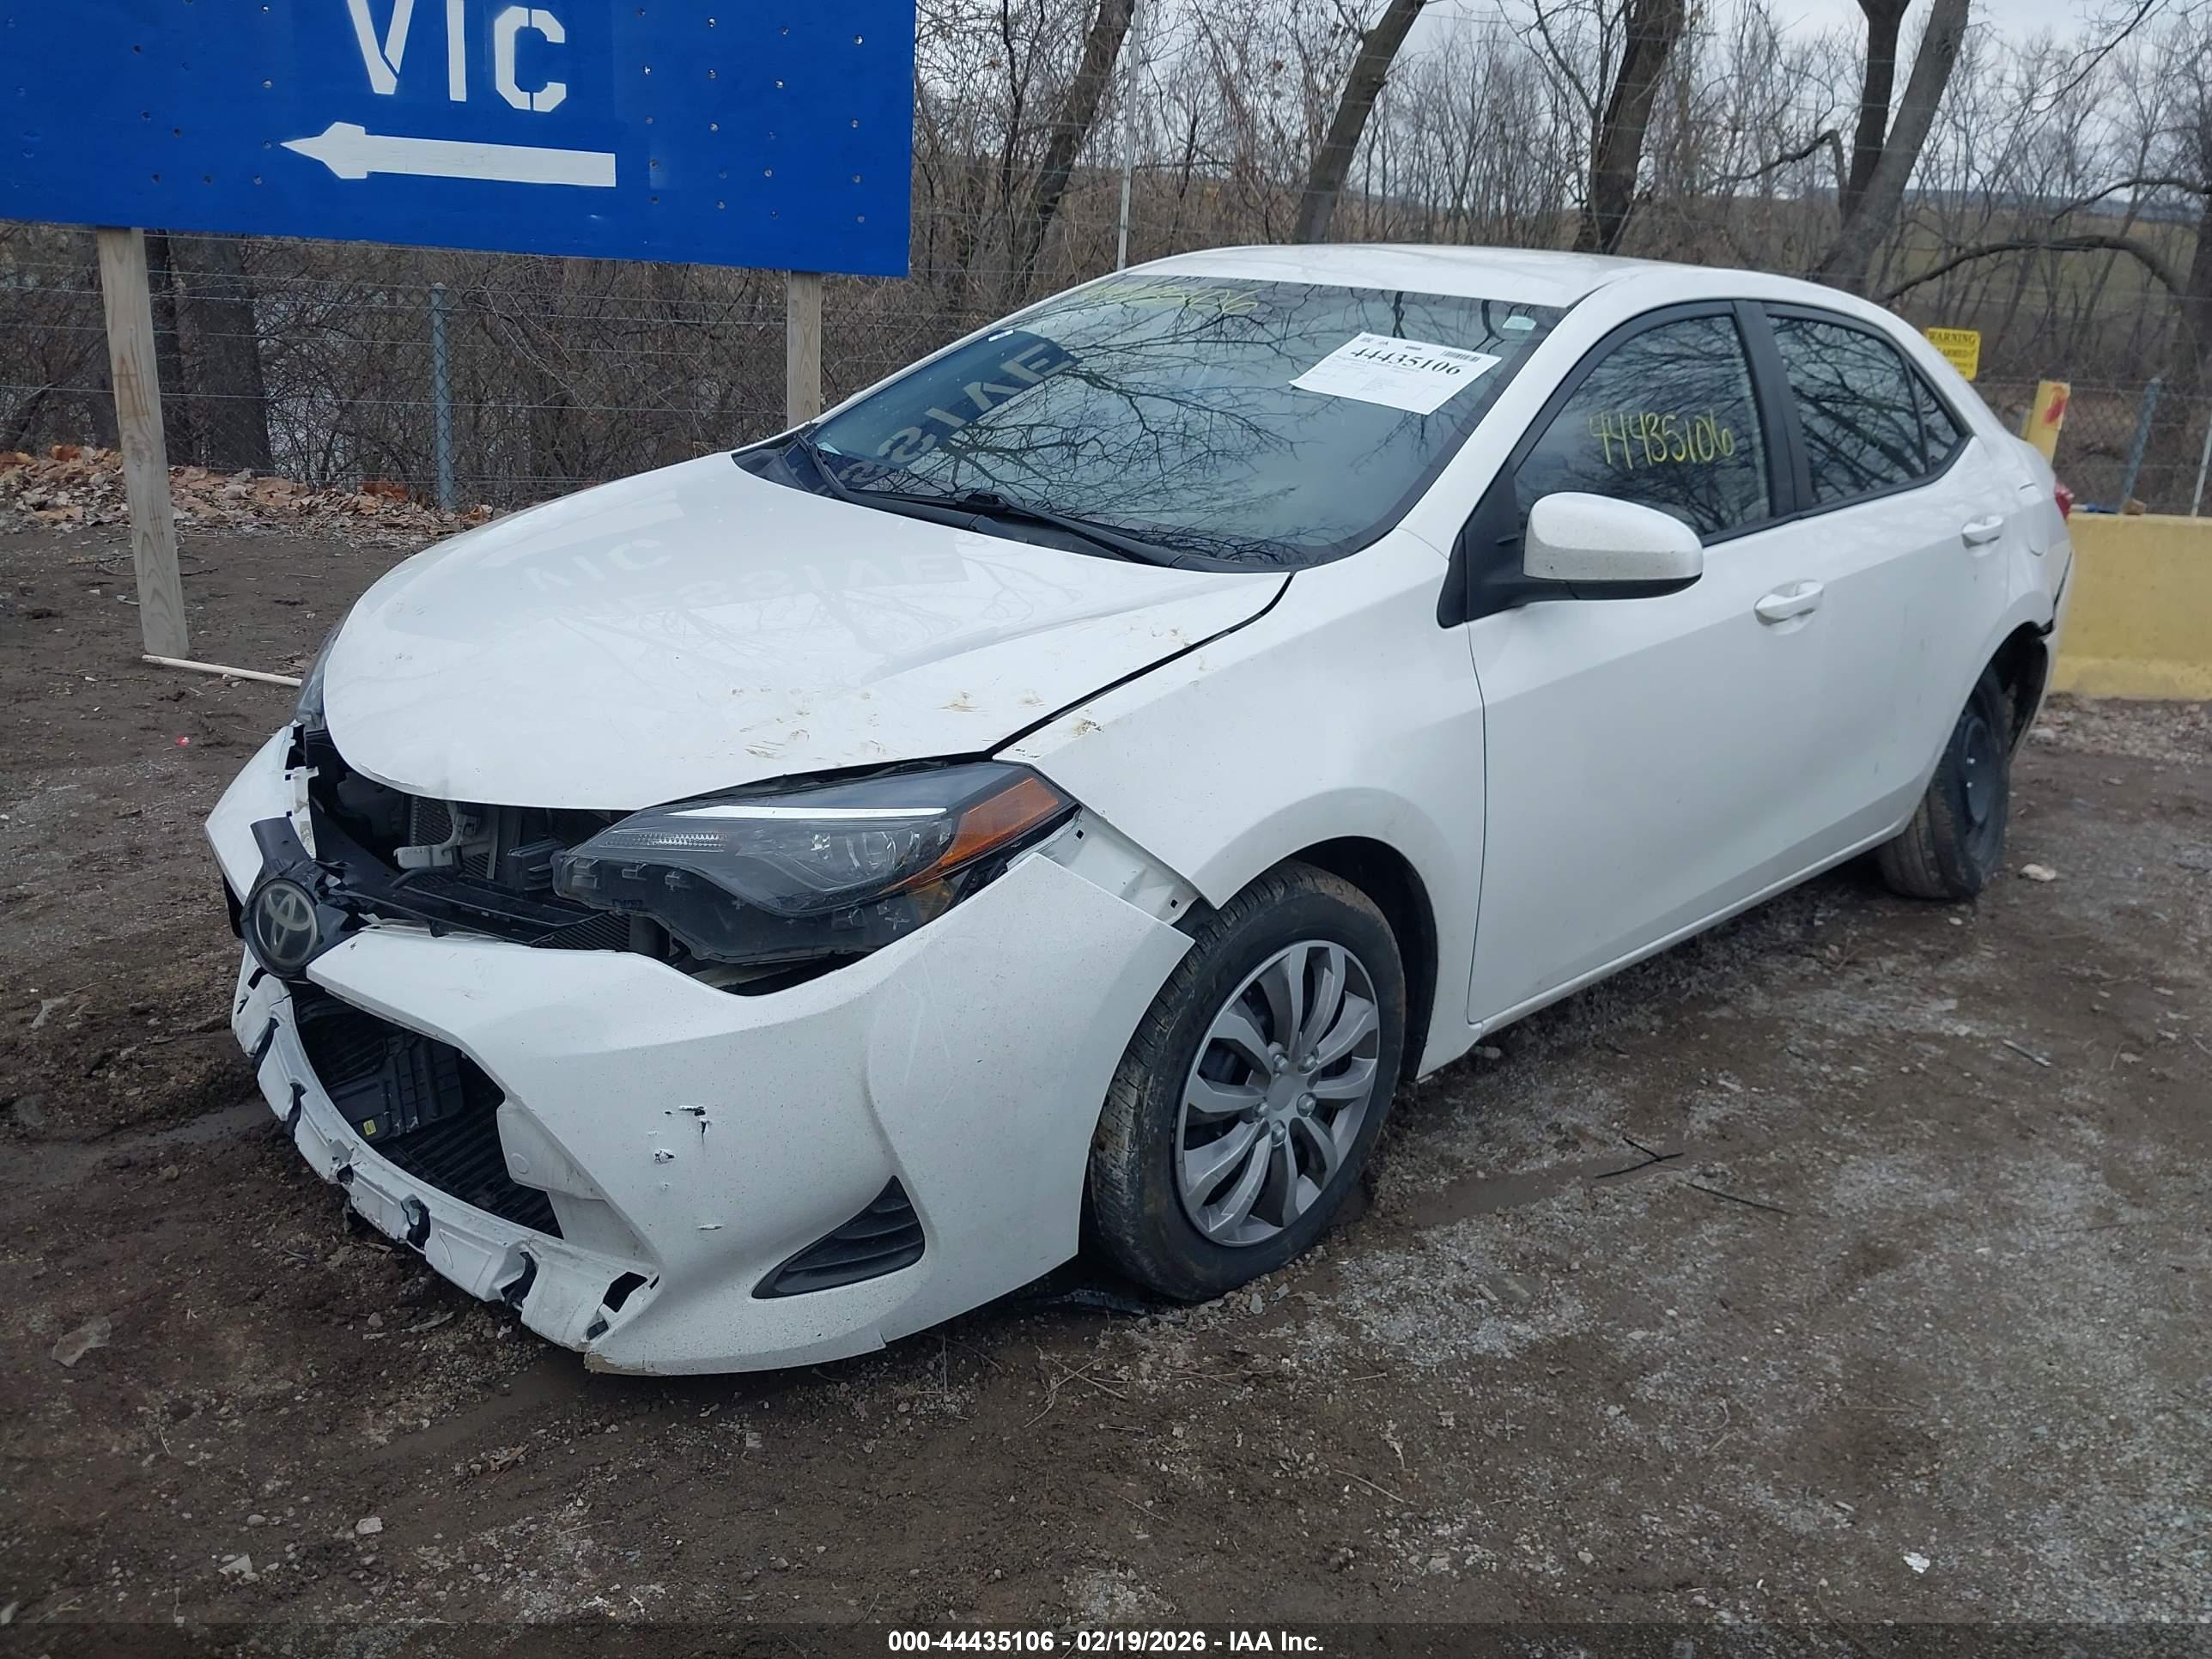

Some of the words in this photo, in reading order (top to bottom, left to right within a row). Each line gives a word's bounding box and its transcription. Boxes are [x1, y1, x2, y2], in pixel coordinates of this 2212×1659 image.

[348, 0, 567, 112] VIC
[1929, 331, 1976, 345] WARNING
[1351, 347, 1462, 375] 44435106
[1589, 409, 1735, 469] 44435106
